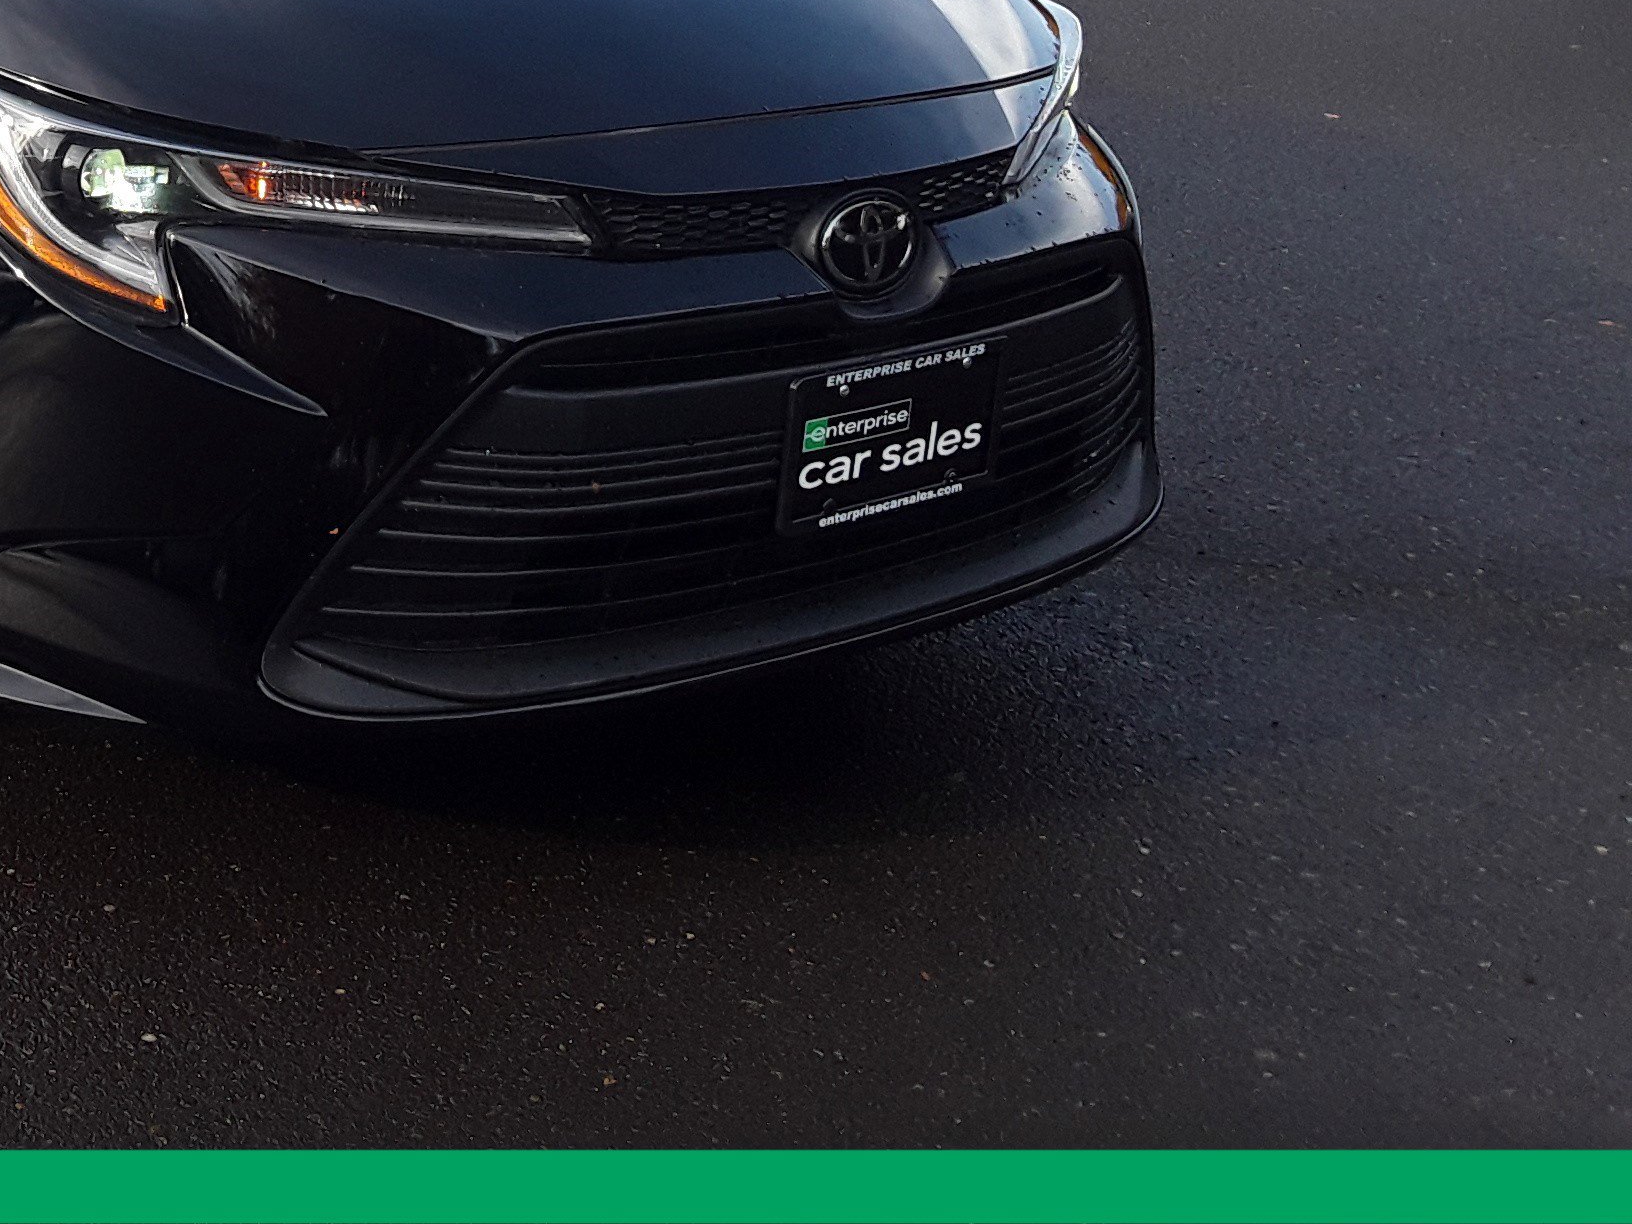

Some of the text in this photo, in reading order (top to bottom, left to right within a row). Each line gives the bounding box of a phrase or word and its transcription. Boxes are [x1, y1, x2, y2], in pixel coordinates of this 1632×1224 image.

[826, 343, 986, 387] ENTERPRISE CAR SALES
[807, 409, 909, 442] enterprise
[798, 421, 983, 490] car sales
[818, 482, 963, 528] enterprisecarsales.com
